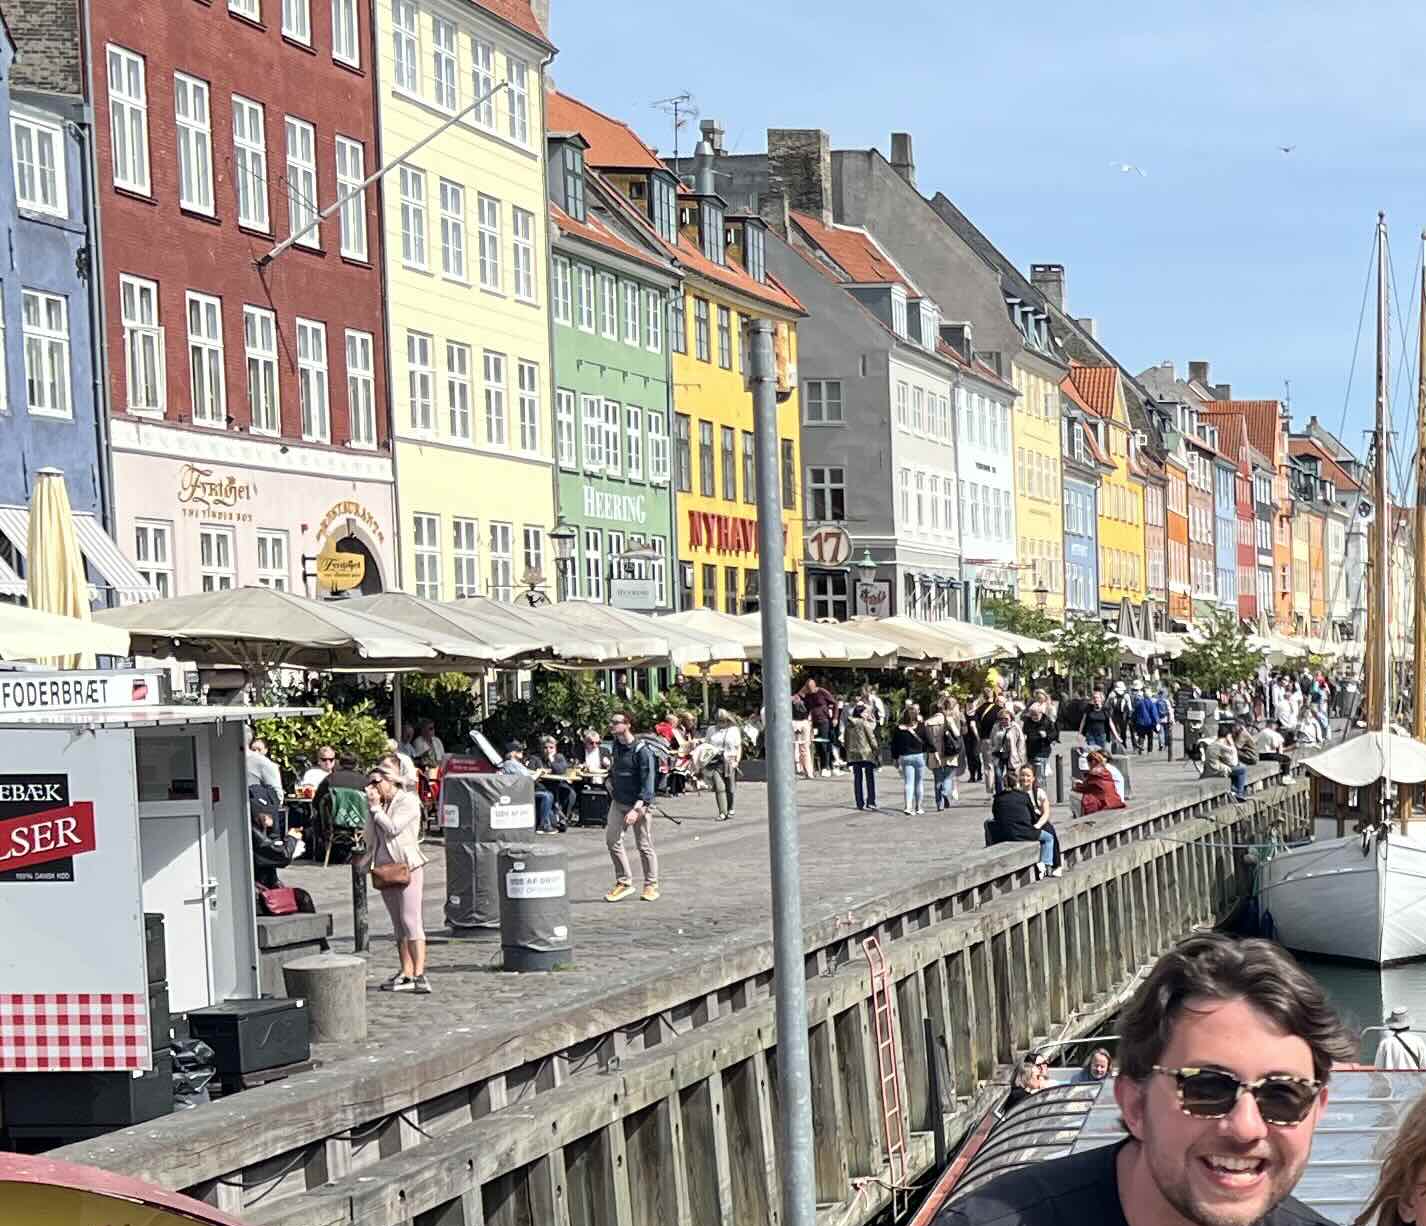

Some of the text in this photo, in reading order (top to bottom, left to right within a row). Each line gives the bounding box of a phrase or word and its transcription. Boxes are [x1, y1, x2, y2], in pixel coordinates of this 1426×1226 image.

[583, 485, 646, 523] HEERING
[688, 510, 760, 560] NYHAV
[811, 532, 841, 562] 17
[2, 679, 108, 708] FODERBRÆT
